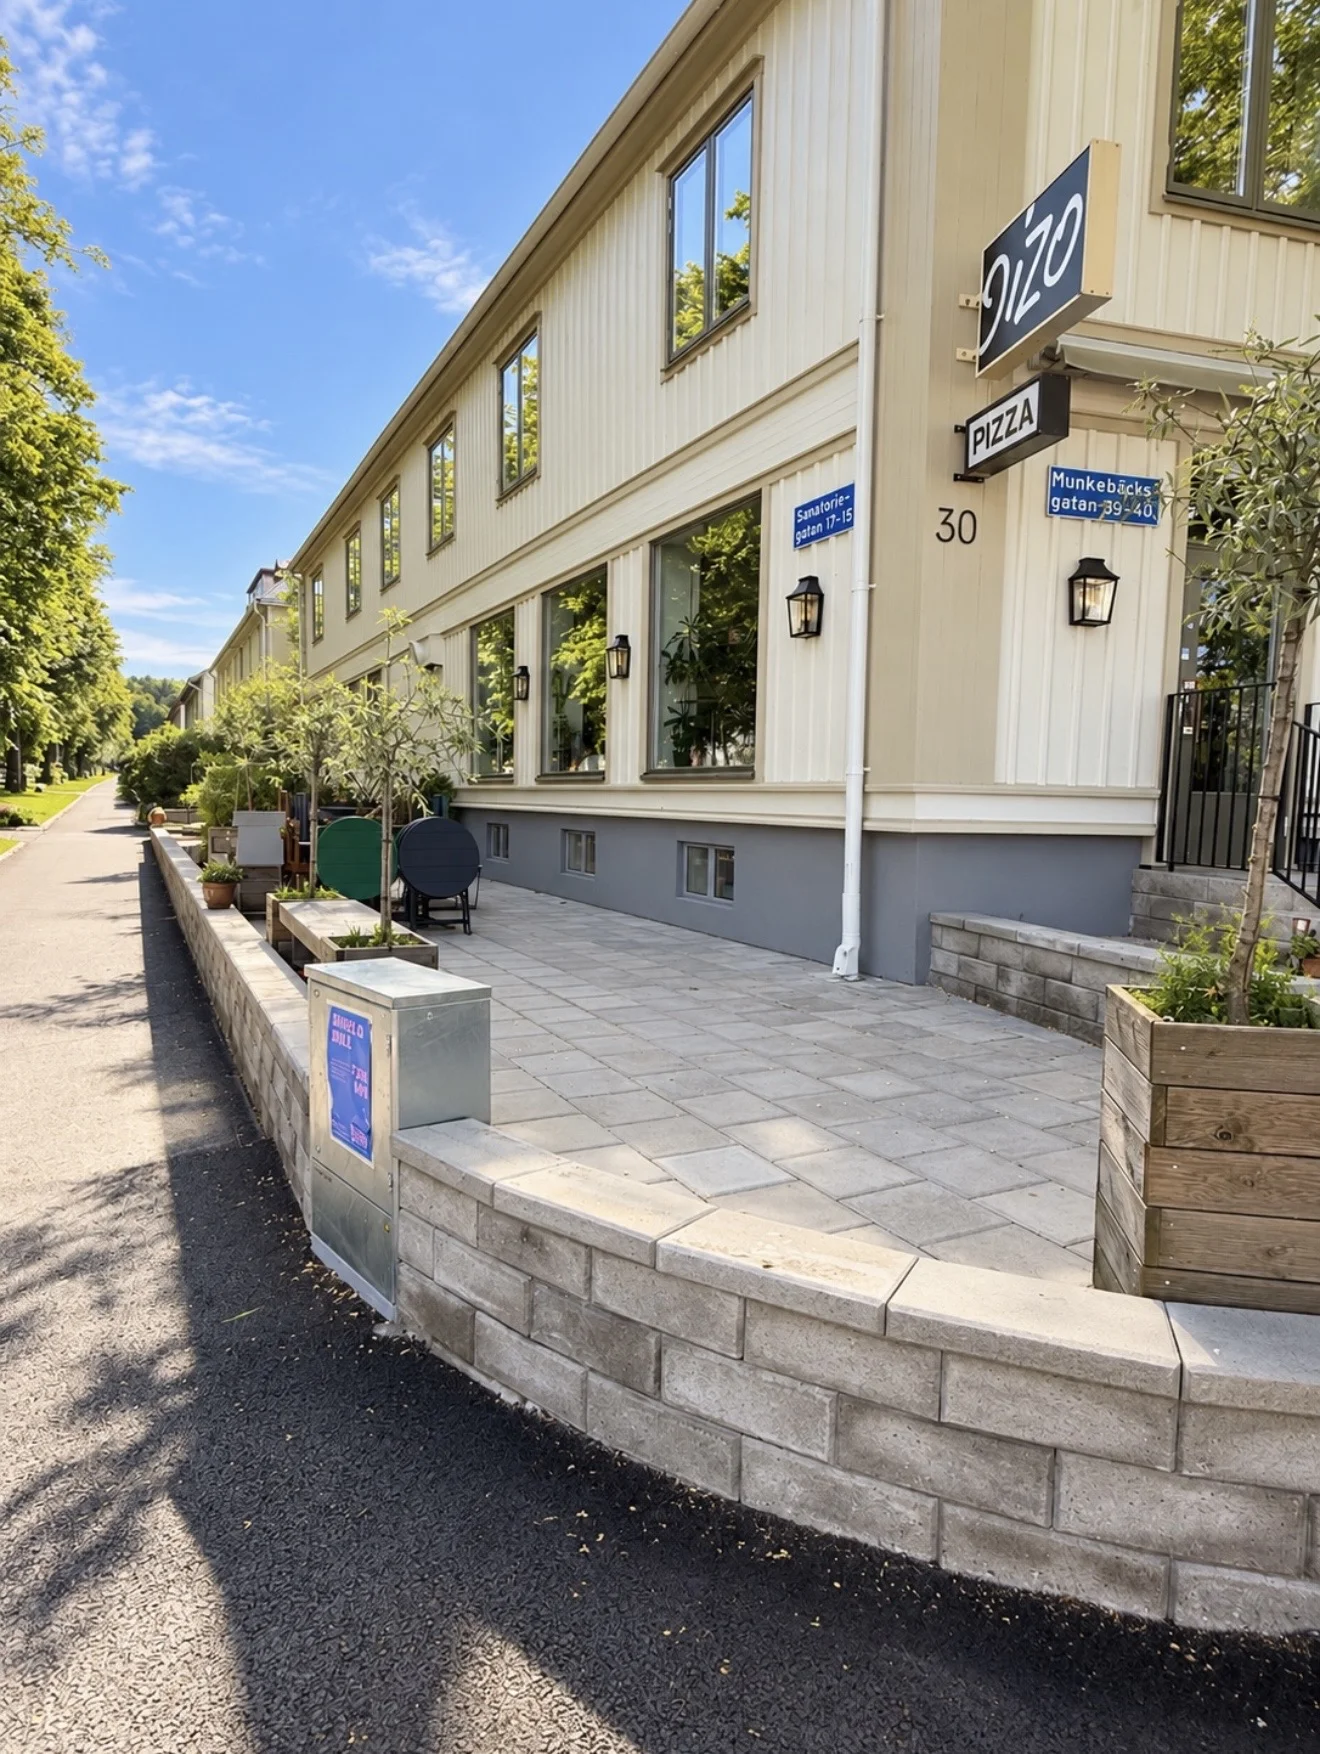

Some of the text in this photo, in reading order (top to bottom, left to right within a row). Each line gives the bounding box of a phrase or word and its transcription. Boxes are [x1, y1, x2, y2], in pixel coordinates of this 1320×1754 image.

[972, 397, 1035, 456] PIZZA
[796, 493, 851, 524] Sanatorie-
[1051, 496, 1098, 513] gatan
[795, 507, 853, 546] gatan 17-15
[935, 507, 977, 544] 30
